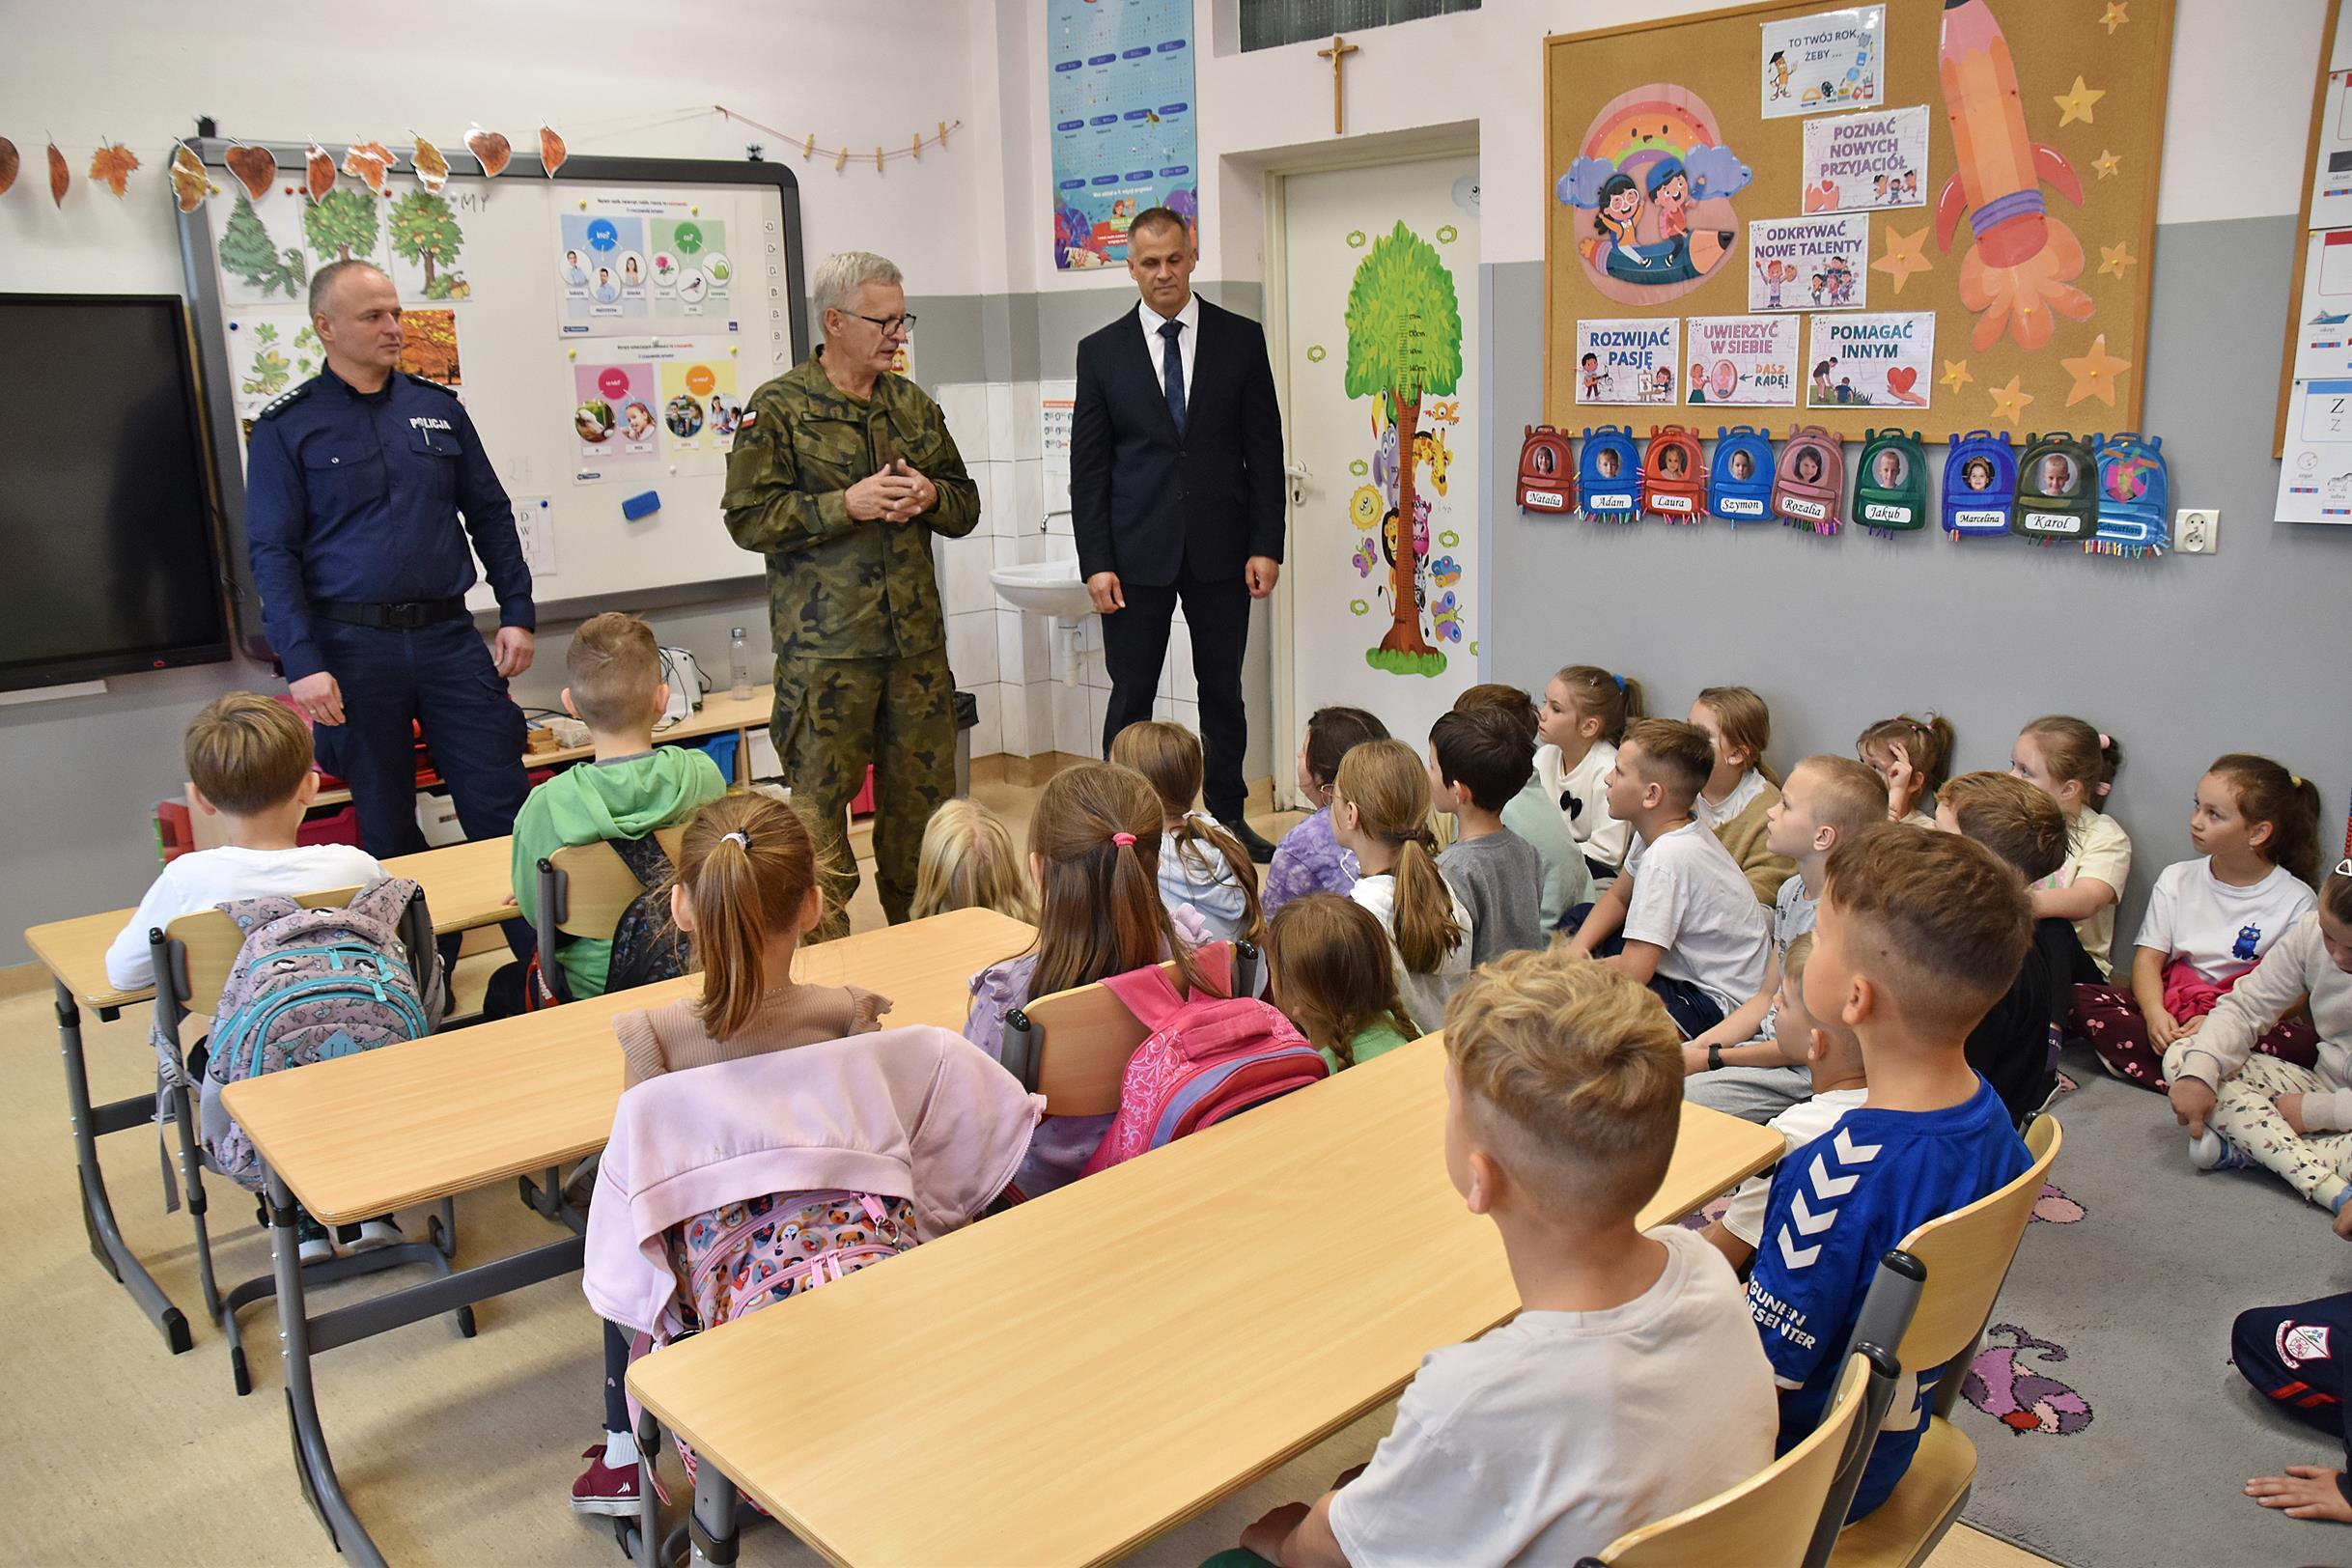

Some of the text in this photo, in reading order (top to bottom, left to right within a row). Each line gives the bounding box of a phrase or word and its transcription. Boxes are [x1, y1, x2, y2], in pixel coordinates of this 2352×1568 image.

[1788, 29, 1860, 48] TO TWÓJ ROK,
[1805, 49, 1831, 62] ŻEBY
[1834, 116, 1896, 141] POZNAĆ
[1830, 138, 1899, 158] NOWYCH
[1820, 153, 1908, 178] PRZYJACIÓŁ
[1766, 220, 1846, 241] ODKRYWAĆ
[1754, 239, 1862, 259] NOWE TALENTY
[1703, 321, 1778, 340] UWIERZYĆ
[1830, 320, 1914, 340] POMAGAĆ
[1589, 327, 1669, 350] ROZWIJAĆ
[1710, 339, 1773, 354] W SIEBIE
[1841, 344, 1898, 358] INNYM
[1608, 350, 1653, 370] PASJĘ
[1754, 363, 1785, 376] DASZ
[1754, 375, 1789, 389] RADĘ!
[2331, 398, 2345, 413] Z
[408, 416, 452, 431] POLICJA
[1528, 492, 1560, 507] Natalia
[1596, 496, 1624, 508] Adam
[1657, 495, 1685, 508] Laura
[1722, 499, 1759, 512] Szymon
[1783, 499, 1821, 517] Rozalia
[1869, 507, 1900, 520] Jakub
[1959, 513, 2000, 524] Marcelina
[2032, 516, 2072, 530] Karol
